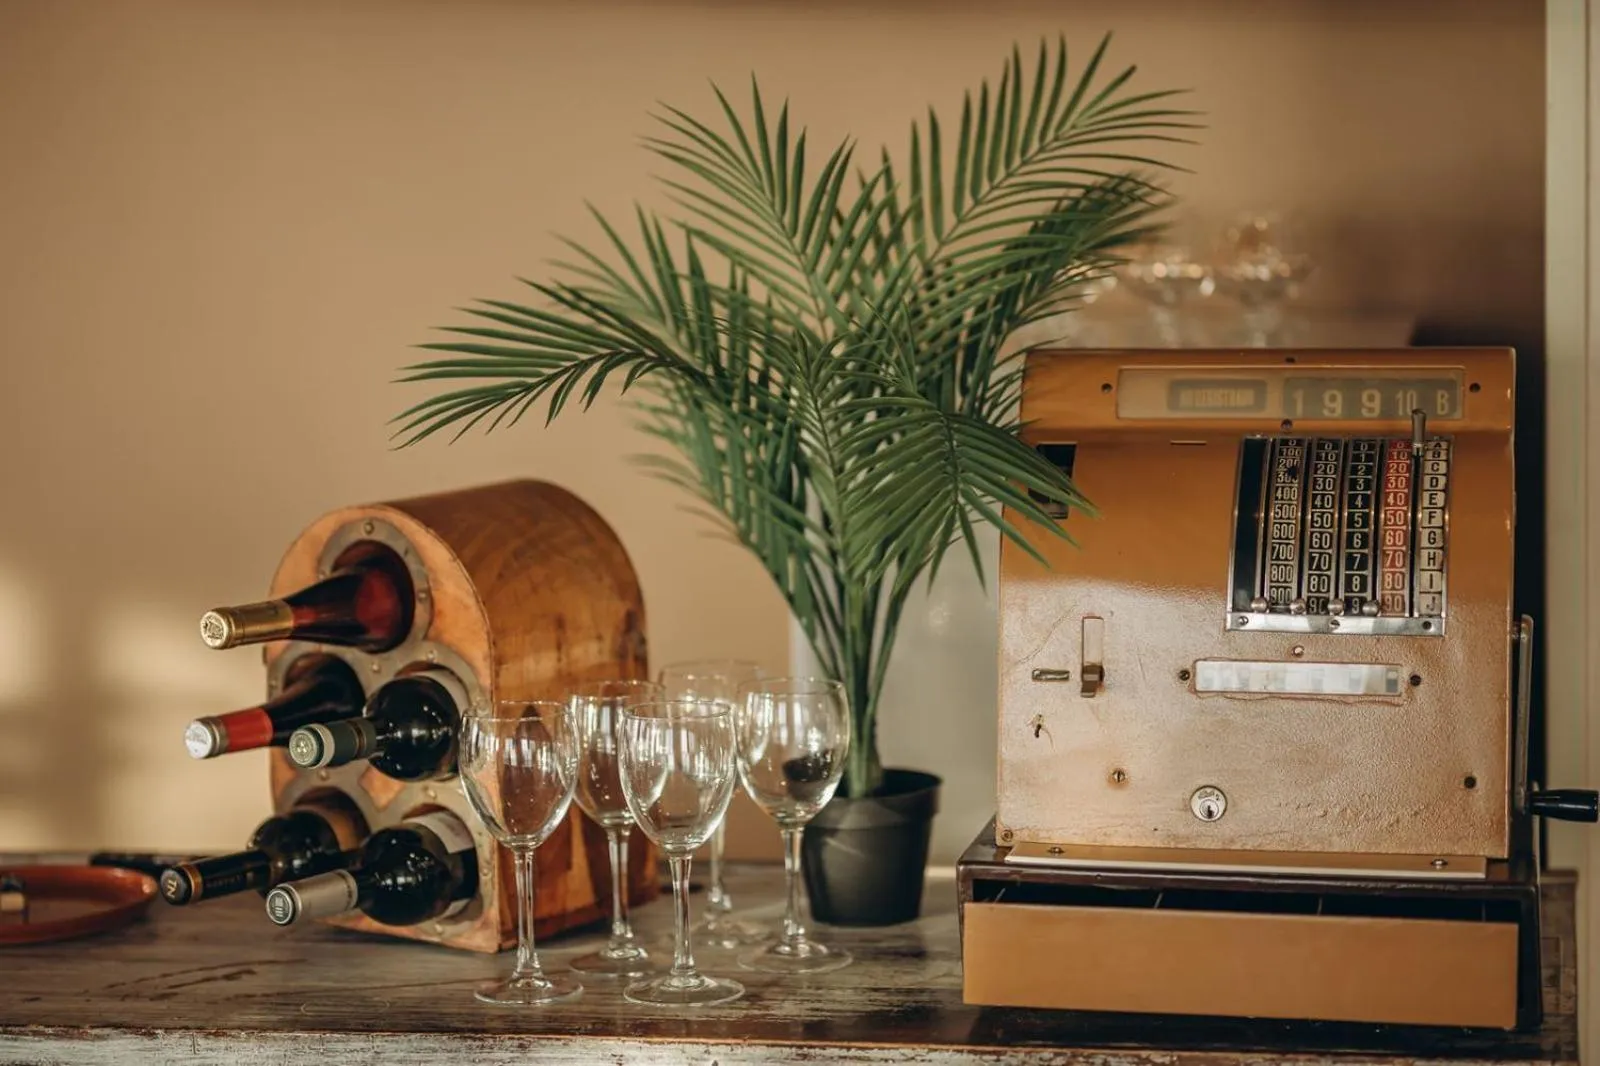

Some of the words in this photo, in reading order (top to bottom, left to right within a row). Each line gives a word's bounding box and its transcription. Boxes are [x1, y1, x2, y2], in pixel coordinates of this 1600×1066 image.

[1292, 389, 1303, 417] 1
[1322, 390, 1342, 417] 9
[1361, 389, 1381, 417] 9
[1395, 390, 1417, 415] 10
[1437, 391, 1449, 415] B
[1320, 453, 1335, 461] 10
[1361, 453, 1365, 462] 1
[1393, 452, 1408, 460] 10
[1317, 462, 1334, 474] 20
[1358, 465, 1365, 475] 2
[1389, 463, 1406, 473] 20
[1432, 462, 1440, 472] C
[1316, 478, 1333, 490] 30
[1356, 478, 1364, 490] 3
[1388, 478, 1405, 488] 30
[1431, 478, 1439, 488] D
[1276, 488, 1297, 499] 400
[1315, 495, 1332, 508] 40
[1355, 495, 1363, 508] 4
[1387, 493, 1404, 506] 40
[1430, 494, 1438, 506] E
[1275, 506, 1295, 518] 500
[1314, 513, 1331, 528] 50
[1354, 513, 1362, 528] 5
[1387, 511, 1404, 524] 50
[1429, 511, 1437, 525] F
[1273, 524, 1294, 538] 600
[1312, 533, 1330, 547] 60
[1354, 533, 1361, 547] 6
[1386, 532, 1403, 545] 60
[1428, 532, 1436, 545] G
[1272, 545, 1293, 560] 700
[1312, 555, 1329, 570] 70
[1353, 555, 1361, 570] 7
[1385, 553, 1403, 568] 70
[1428, 554, 1436, 568] H
[1271, 566, 1292, 582] 800
[1310, 575, 1328, 591] 80
[1352, 577, 1360, 591] 8
[1384, 573, 1402, 590] 80
[1429, 575, 1433, 590] I
[1270, 588, 1292, 604] 900
[1352, 599, 1360, 613] 9
[1383, 595, 1402, 610] 90
[1427, 597, 1436, 610] J
